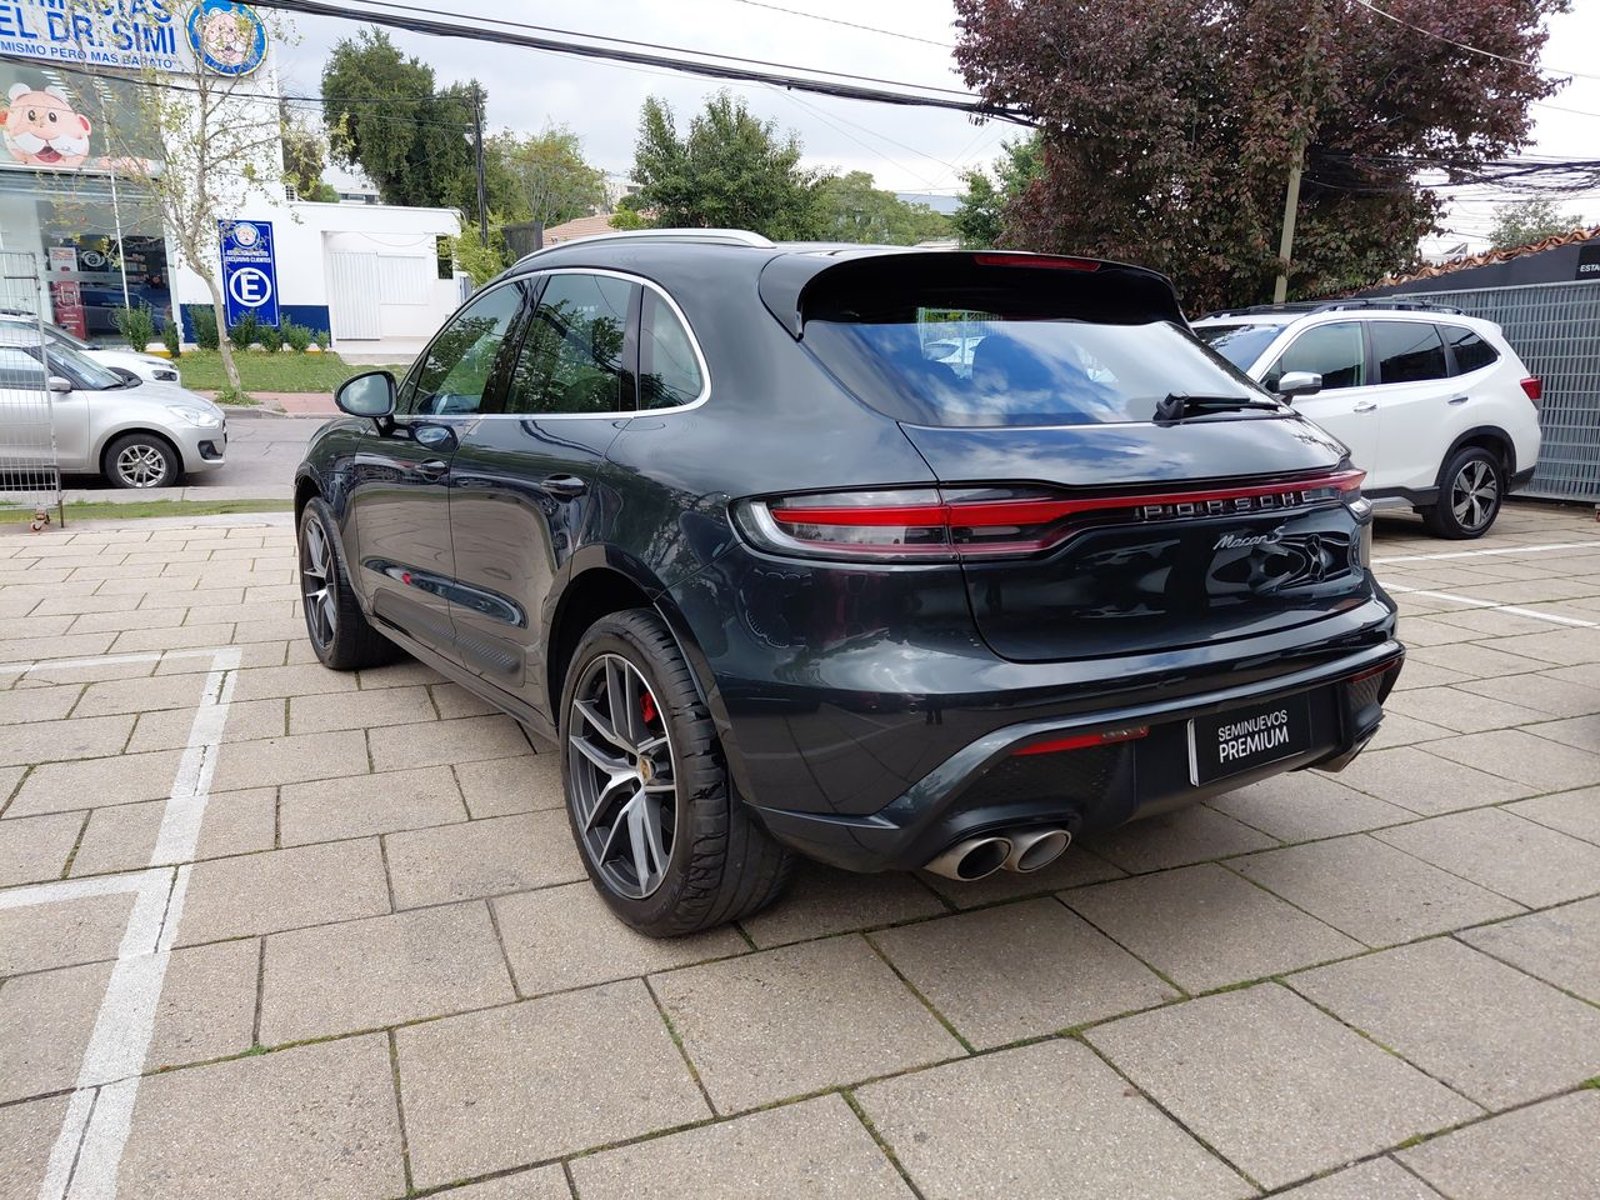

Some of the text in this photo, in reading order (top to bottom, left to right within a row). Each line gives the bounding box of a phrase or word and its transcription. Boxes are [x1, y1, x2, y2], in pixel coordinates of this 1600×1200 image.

[0, 5, 38, 39] EL
[112, 20, 176, 54] SIMI
[50, 46, 87, 60] PERO
[90, 51, 119, 63] MAS
[240, 274, 261, 301] E
[1213, 526, 1286, 550] Macan S
[1218, 709, 1288, 742] SEMINUEVOS
[1219, 725, 1289, 763] PREMIUM
